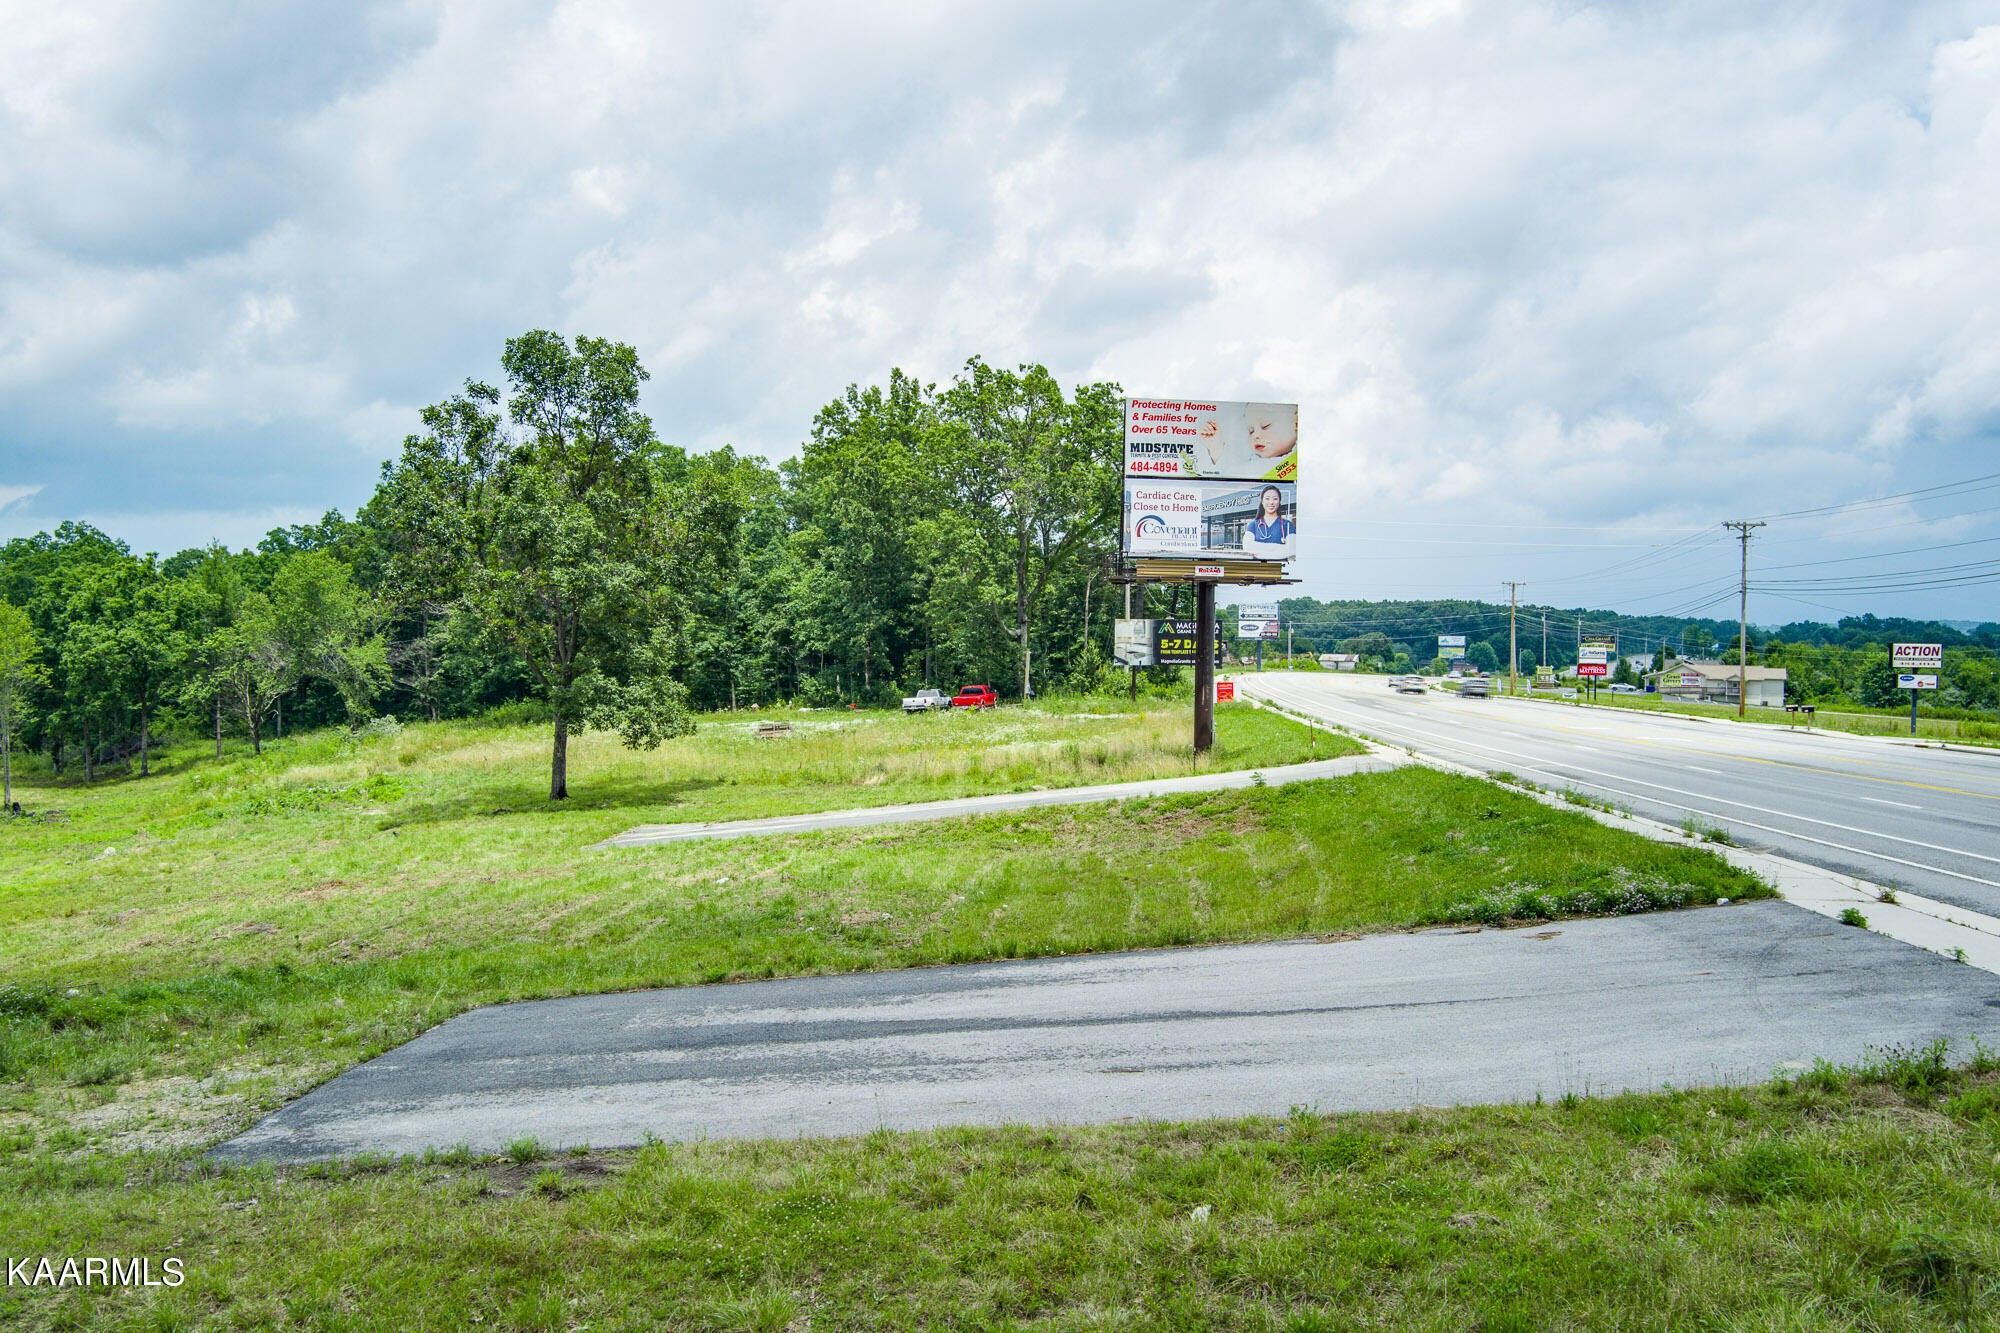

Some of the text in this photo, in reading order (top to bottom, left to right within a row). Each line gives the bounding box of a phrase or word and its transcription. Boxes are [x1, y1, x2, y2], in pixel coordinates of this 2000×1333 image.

[1132, 400, 1217, 411] Protecting Homes
[1132, 413, 1197, 423] & Families for
[1132, 425, 1197, 435] Over 65 Years
[1130, 442, 1194, 454] MIDSTATE
[1130, 461, 1178, 473] 484-4894
[1277, 463, 1297, 479] 1953
[1136, 491, 1171, 501] Cardiac
[1133, 502, 1199, 513] Close to Home
[1143, 523, 1198, 535] Covenant
[1160, 639, 1182, 649] 5-7
[1895, 646, 1940, 657] ACTION
